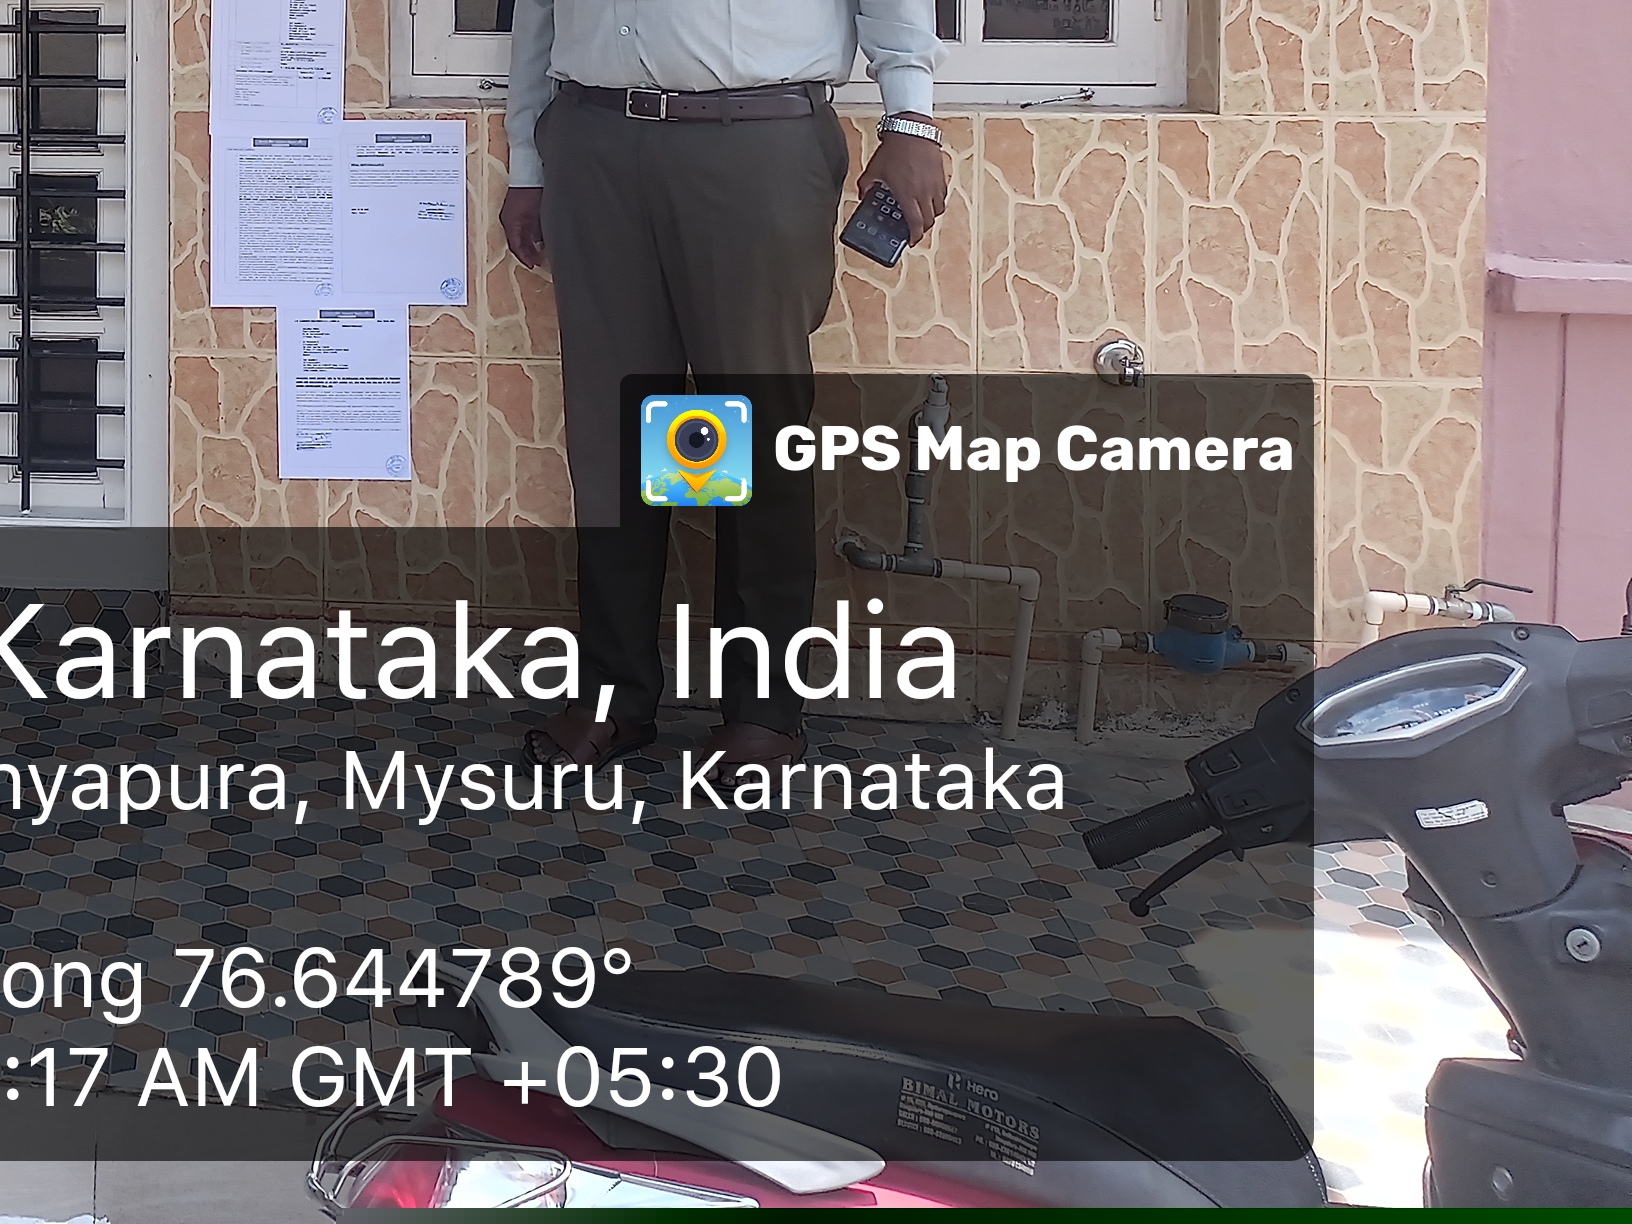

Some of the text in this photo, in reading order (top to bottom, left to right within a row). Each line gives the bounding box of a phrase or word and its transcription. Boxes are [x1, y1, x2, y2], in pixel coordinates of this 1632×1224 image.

[901, 1076, 959, 1107] BIMAL
[967, 1098, 1040, 1140] MOTORS
[966, 1079, 1000, 1102] Hero
